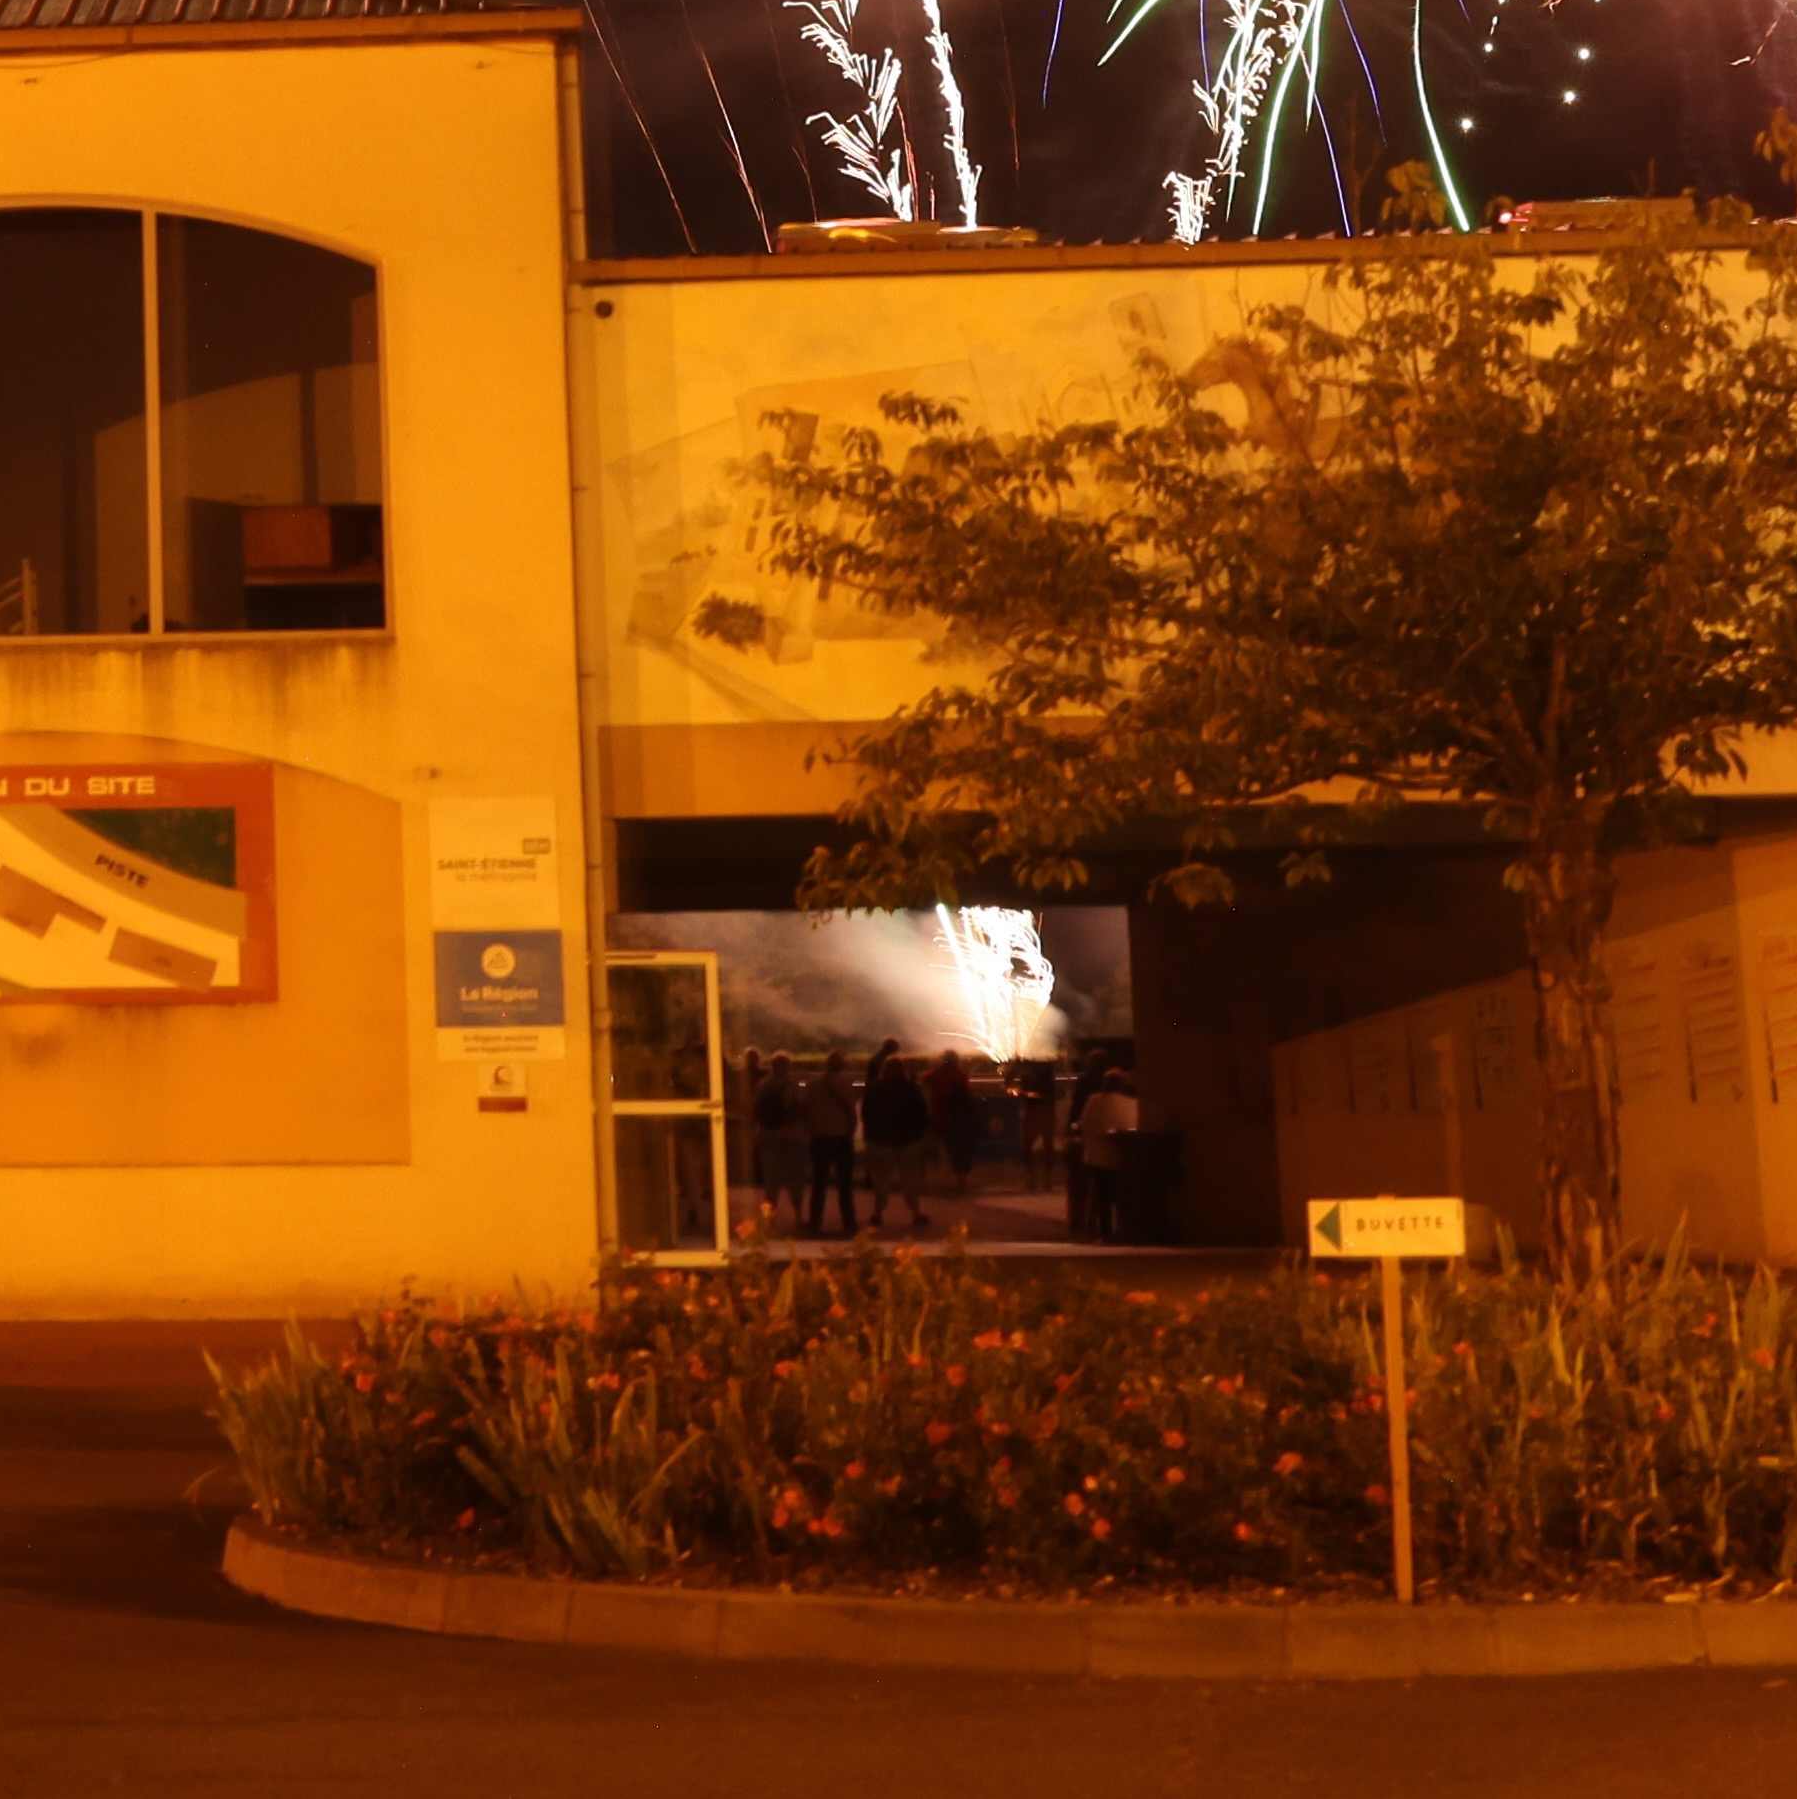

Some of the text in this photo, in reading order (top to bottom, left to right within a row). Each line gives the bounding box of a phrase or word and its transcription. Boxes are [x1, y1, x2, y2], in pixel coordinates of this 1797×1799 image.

[24, 777, 71, 796] DU
[87, 776, 155, 795] SITE
[95, 854, 148, 887] PISTE
[1355, 1215, 1444, 1232] BUVETTE
